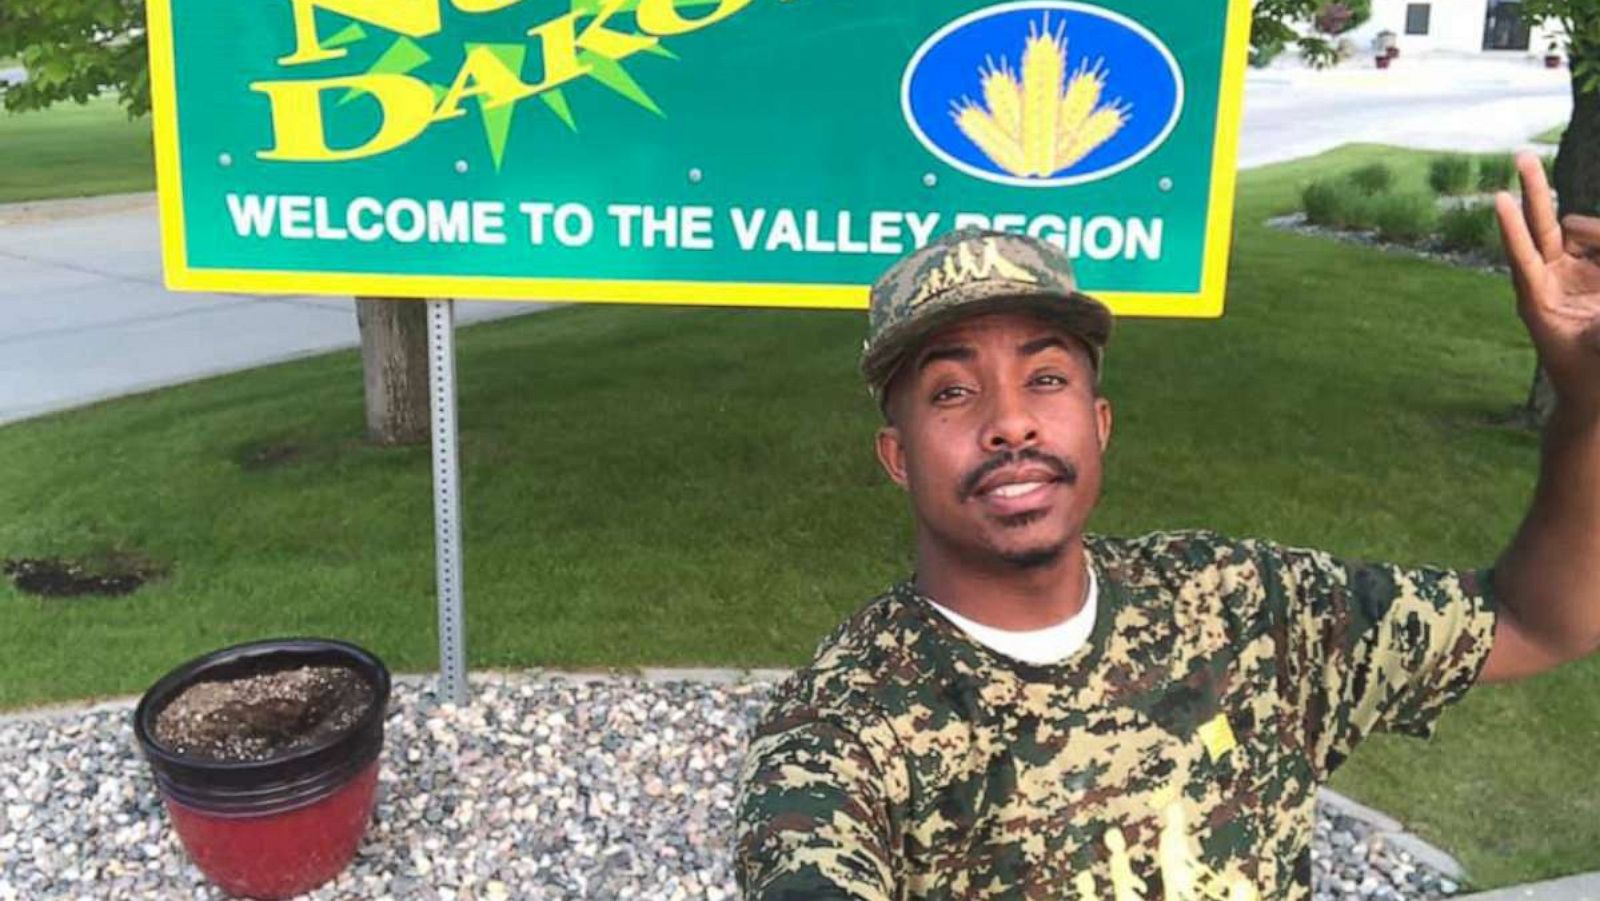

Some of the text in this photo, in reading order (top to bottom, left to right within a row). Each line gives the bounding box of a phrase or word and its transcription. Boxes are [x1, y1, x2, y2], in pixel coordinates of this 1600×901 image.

[226, 193, 507, 245] WELCOME
[519, 202, 594, 247] TO
[607, 204, 713, 249] THE
[730, 207, 941, 254] VALLEY
